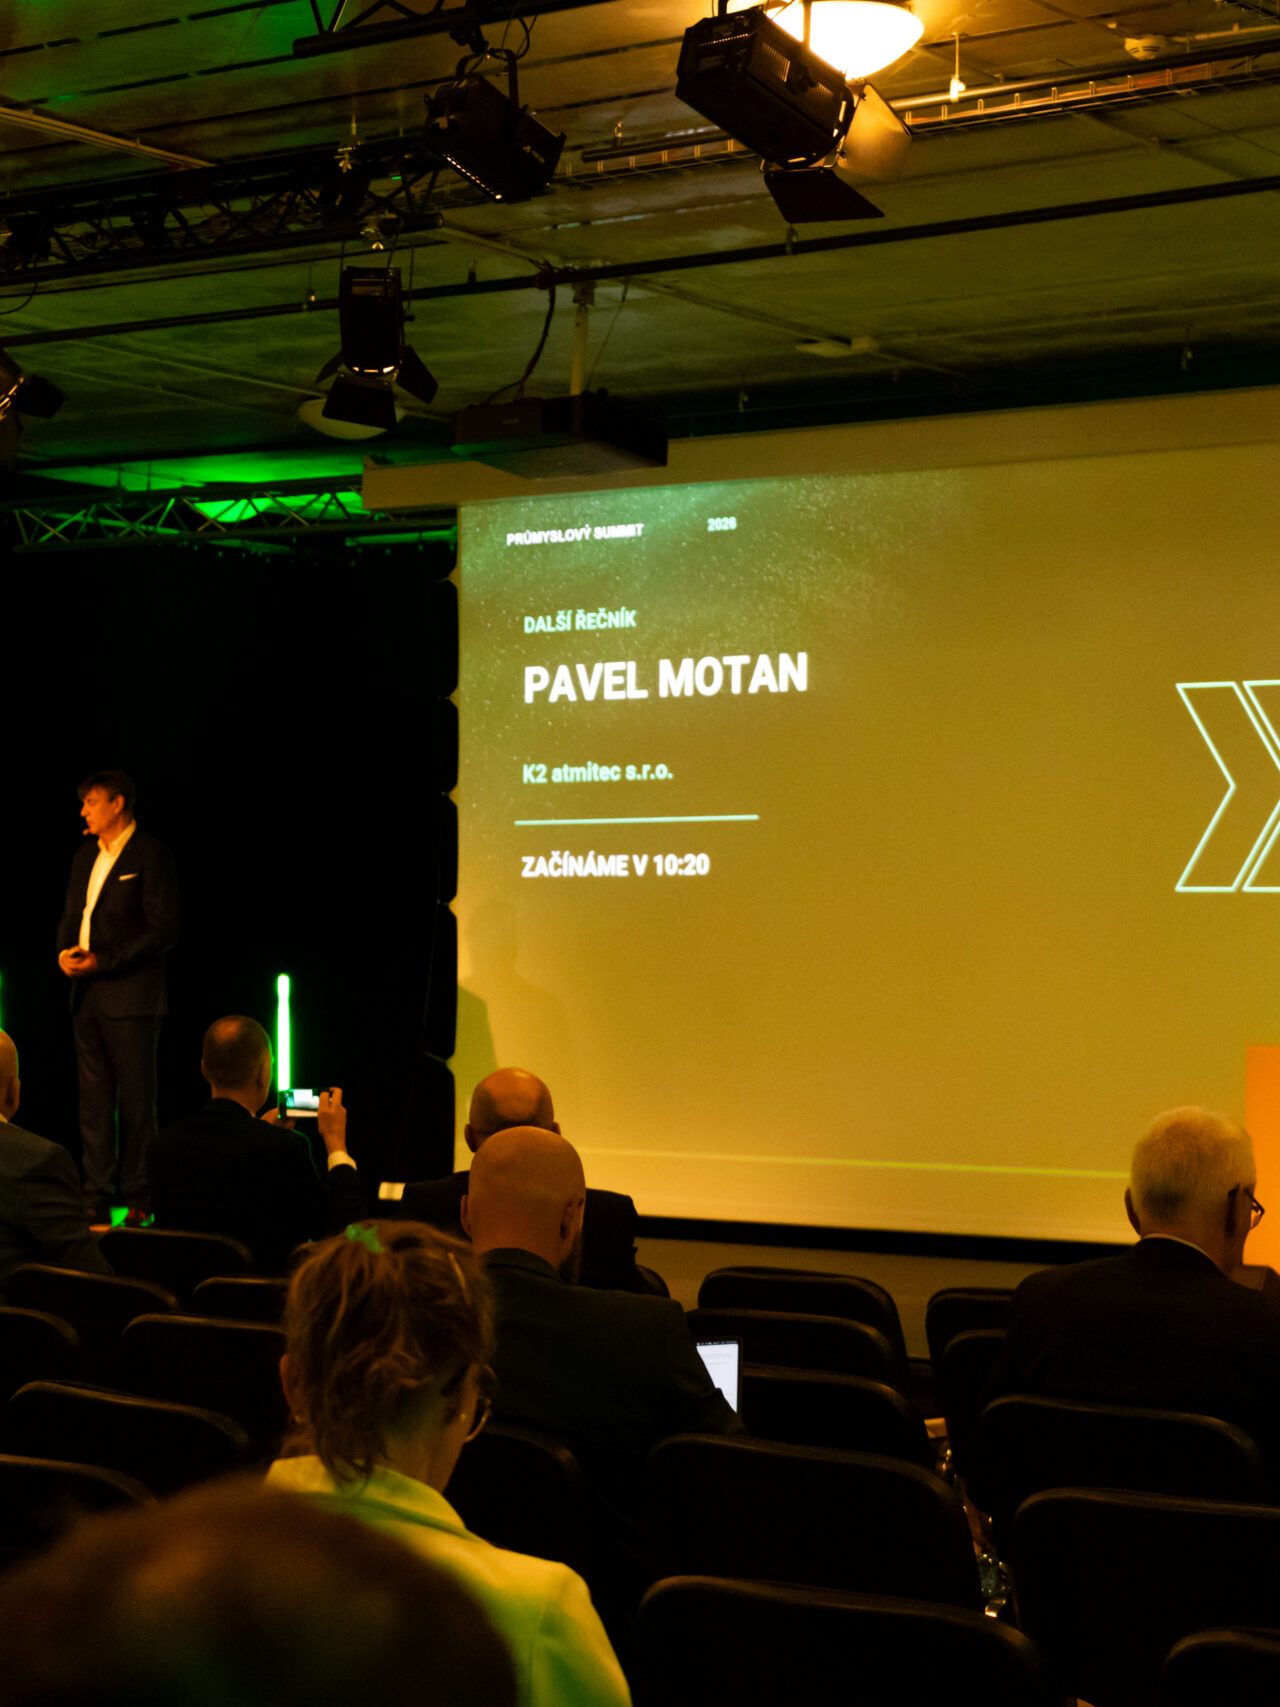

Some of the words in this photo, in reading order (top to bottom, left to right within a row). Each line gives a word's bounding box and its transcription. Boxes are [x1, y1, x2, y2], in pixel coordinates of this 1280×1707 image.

[506, 524, 592, 546] PRŮMYSLOVÝ
[593, 523, 644, 539] SUMMIT
[707, 516, 737, 531] 2026
[524, 610, 572, 633] DALŠÍ
[575, 606, 637, 630] ŘEČNÍK
[524, 661, 649, 703] PAVEL
[658, 652, 808, 698] MOTAN
[522, 764, 547, 783] K2
[552, 761, 621, 782] atmitec
[625, 764, 673, 781] s.r.o.
[521, 851, 629, 877] ZAČÍNÁME
[632, 855, 648, 876] V
[653, 853, 710, 876] 10:20
